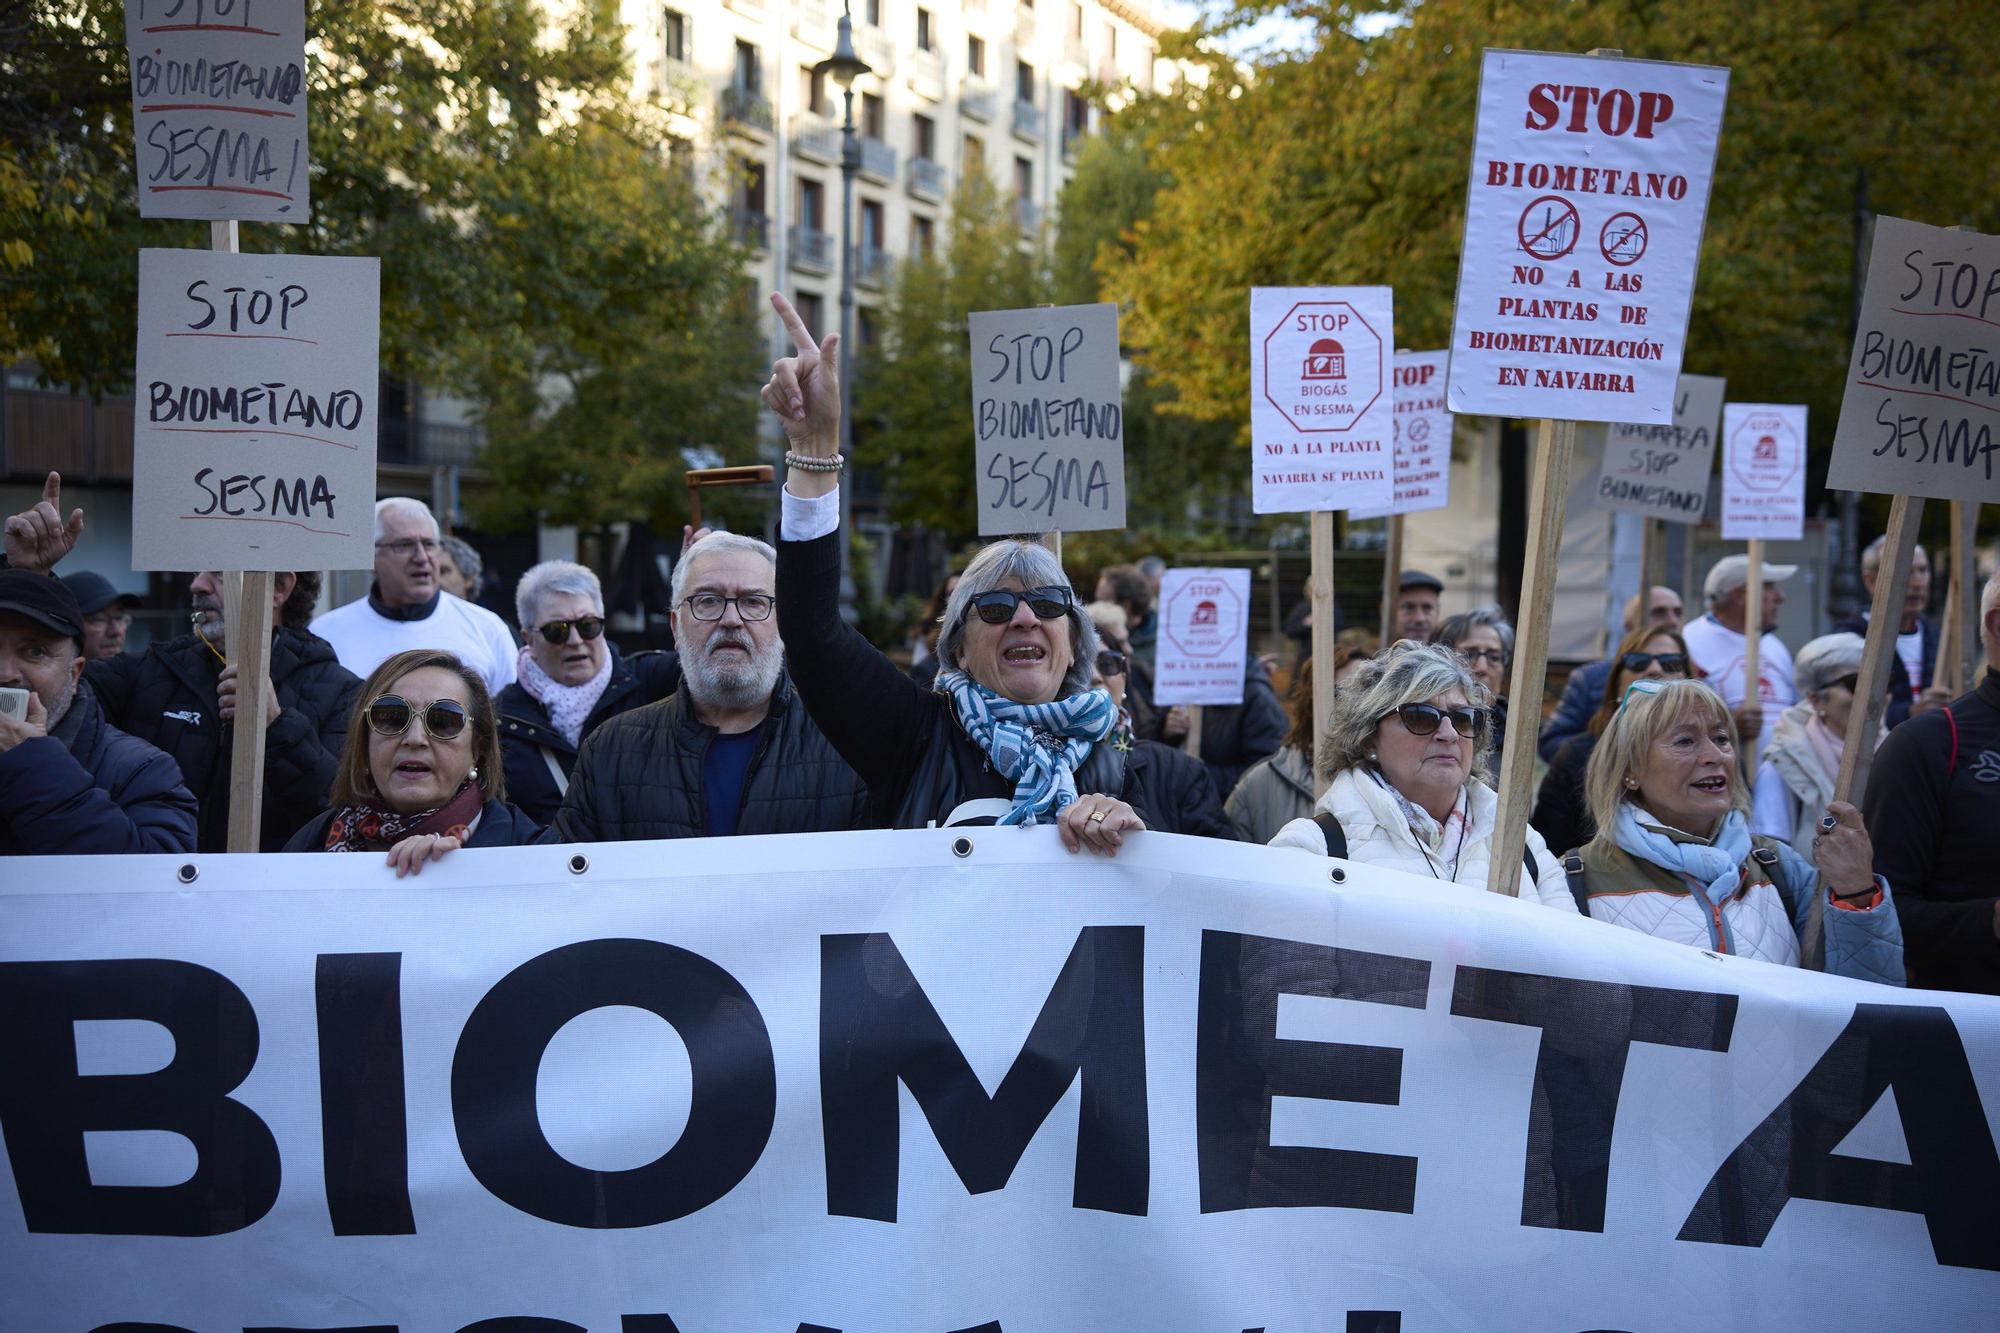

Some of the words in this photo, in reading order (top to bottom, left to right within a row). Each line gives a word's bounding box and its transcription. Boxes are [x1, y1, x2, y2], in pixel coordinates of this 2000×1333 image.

[1525, 83, 1675, 139] STOP
[1486, 160, 1688, 200] BIOMETANO
[1511, 265, 1544, 286] NO
[1566, 269, 1582, 288] A
[1604, 272, 1643, 292] LAS
[1900, 249, 2000, 318] STOP
[186, 280, 309, 332] STOP
[1297, 314, 1349, 332] STOP
[1498, 297, 1599, 322] PLANTAS
[1620, 305, 1648, 325] DE
[989, 327, 1084, 384] STOP
[1468, 330, 1664, 361] BIOMETANIZACIÓN
[1301, 382, 1348, 397] BIOGÁS
[1498, 367, 1529, 386] EN
[1534, 369, 1636, 393] NAVARRA
[149, 381, 363, 430] BIOMETANO
[979, 397, 1120, 441] BIOMETANO
[1294, 404, 1312, 416] EN
[1314, 404, 1355, 416] SESMA
[1265, 443, 1284, 456] NO
[1290, 443, 1299, 455] A
[1307, 442, 1323, 454] LA
[1330, 441, 1382, 453] PLANTA
[1872, 398, 2000, 480] SESMA
[1262, 473, 1317, 485] NAVARRA
[1322, 472, 1337, 483] SE
[1342, 470, 1385, 482] PLANTA
[1630, 448, 1680, 475] STOP
[194, 467, 336, 519] SESMA
[988, 452, 1111, 517] SESMA
[0, 925, 2000, 1272] BIOMETA
